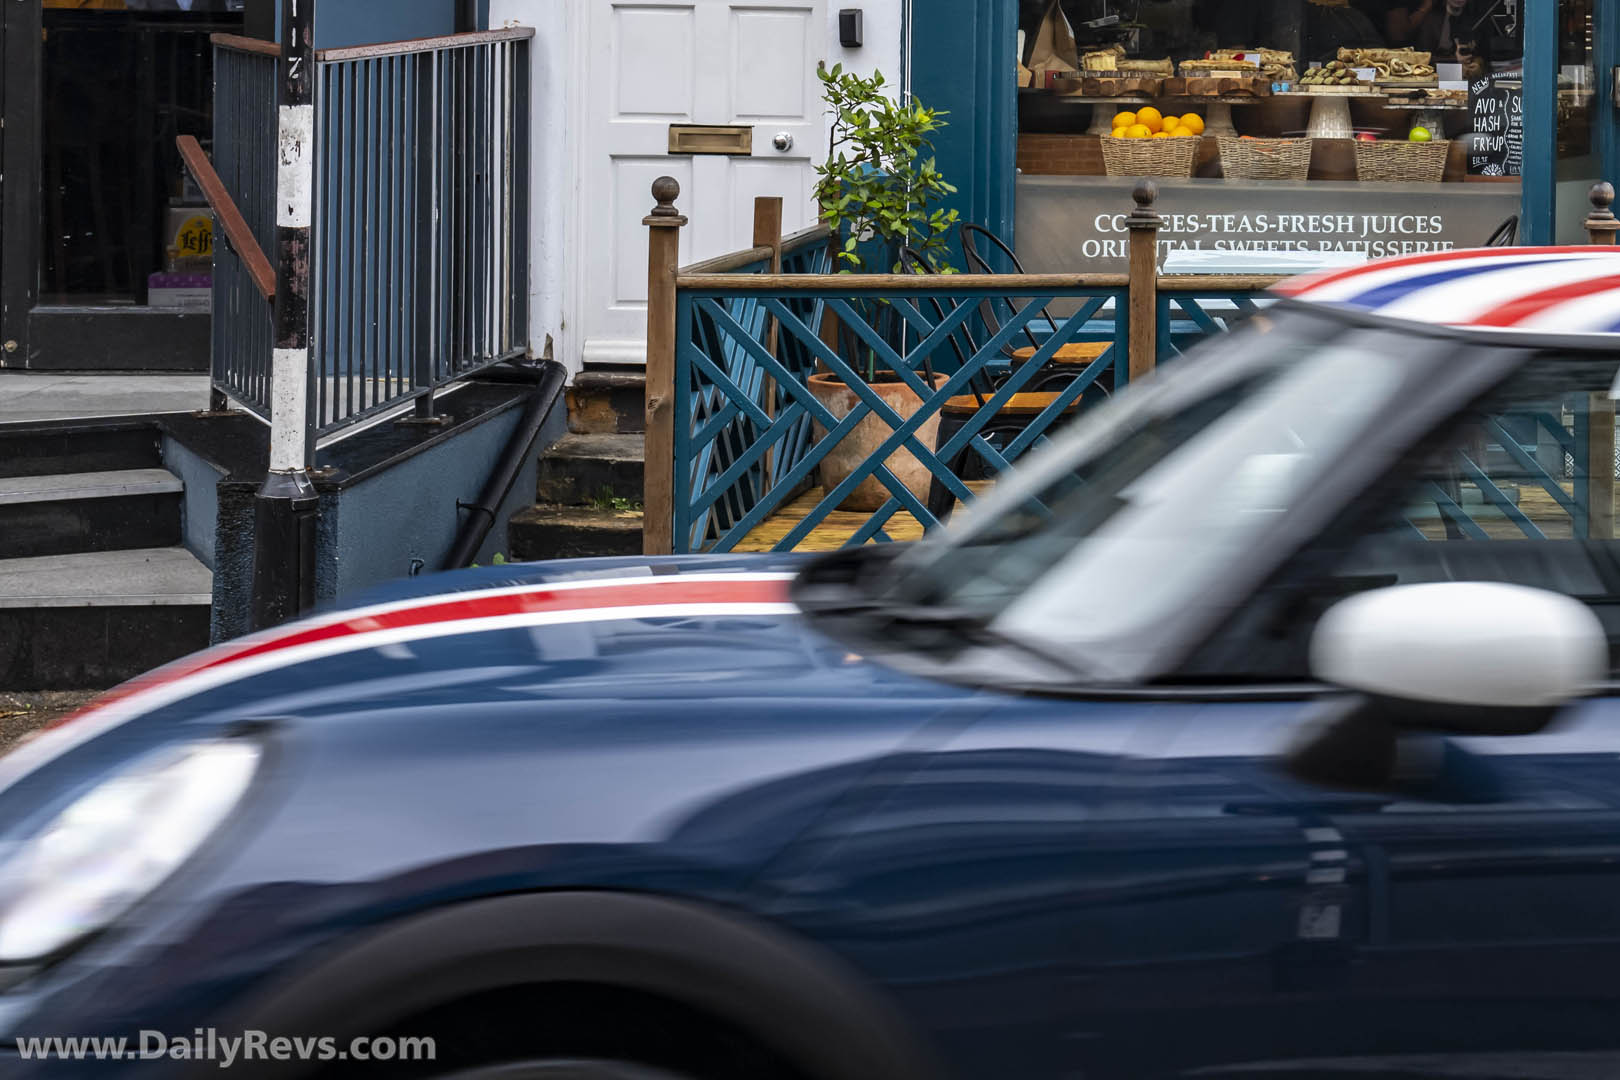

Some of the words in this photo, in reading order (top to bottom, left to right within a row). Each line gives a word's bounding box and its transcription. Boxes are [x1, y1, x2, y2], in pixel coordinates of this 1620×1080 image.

[1474, 98, 1496, 114] AVO
[1473, 115, 1501, 132] HASH
[1473, 136, 1504, 152] FRY-UP
[1094, 214, 1355, 234] COEES-TEAS-FRESH
[1360, 215, 1443, 238] JUICES
